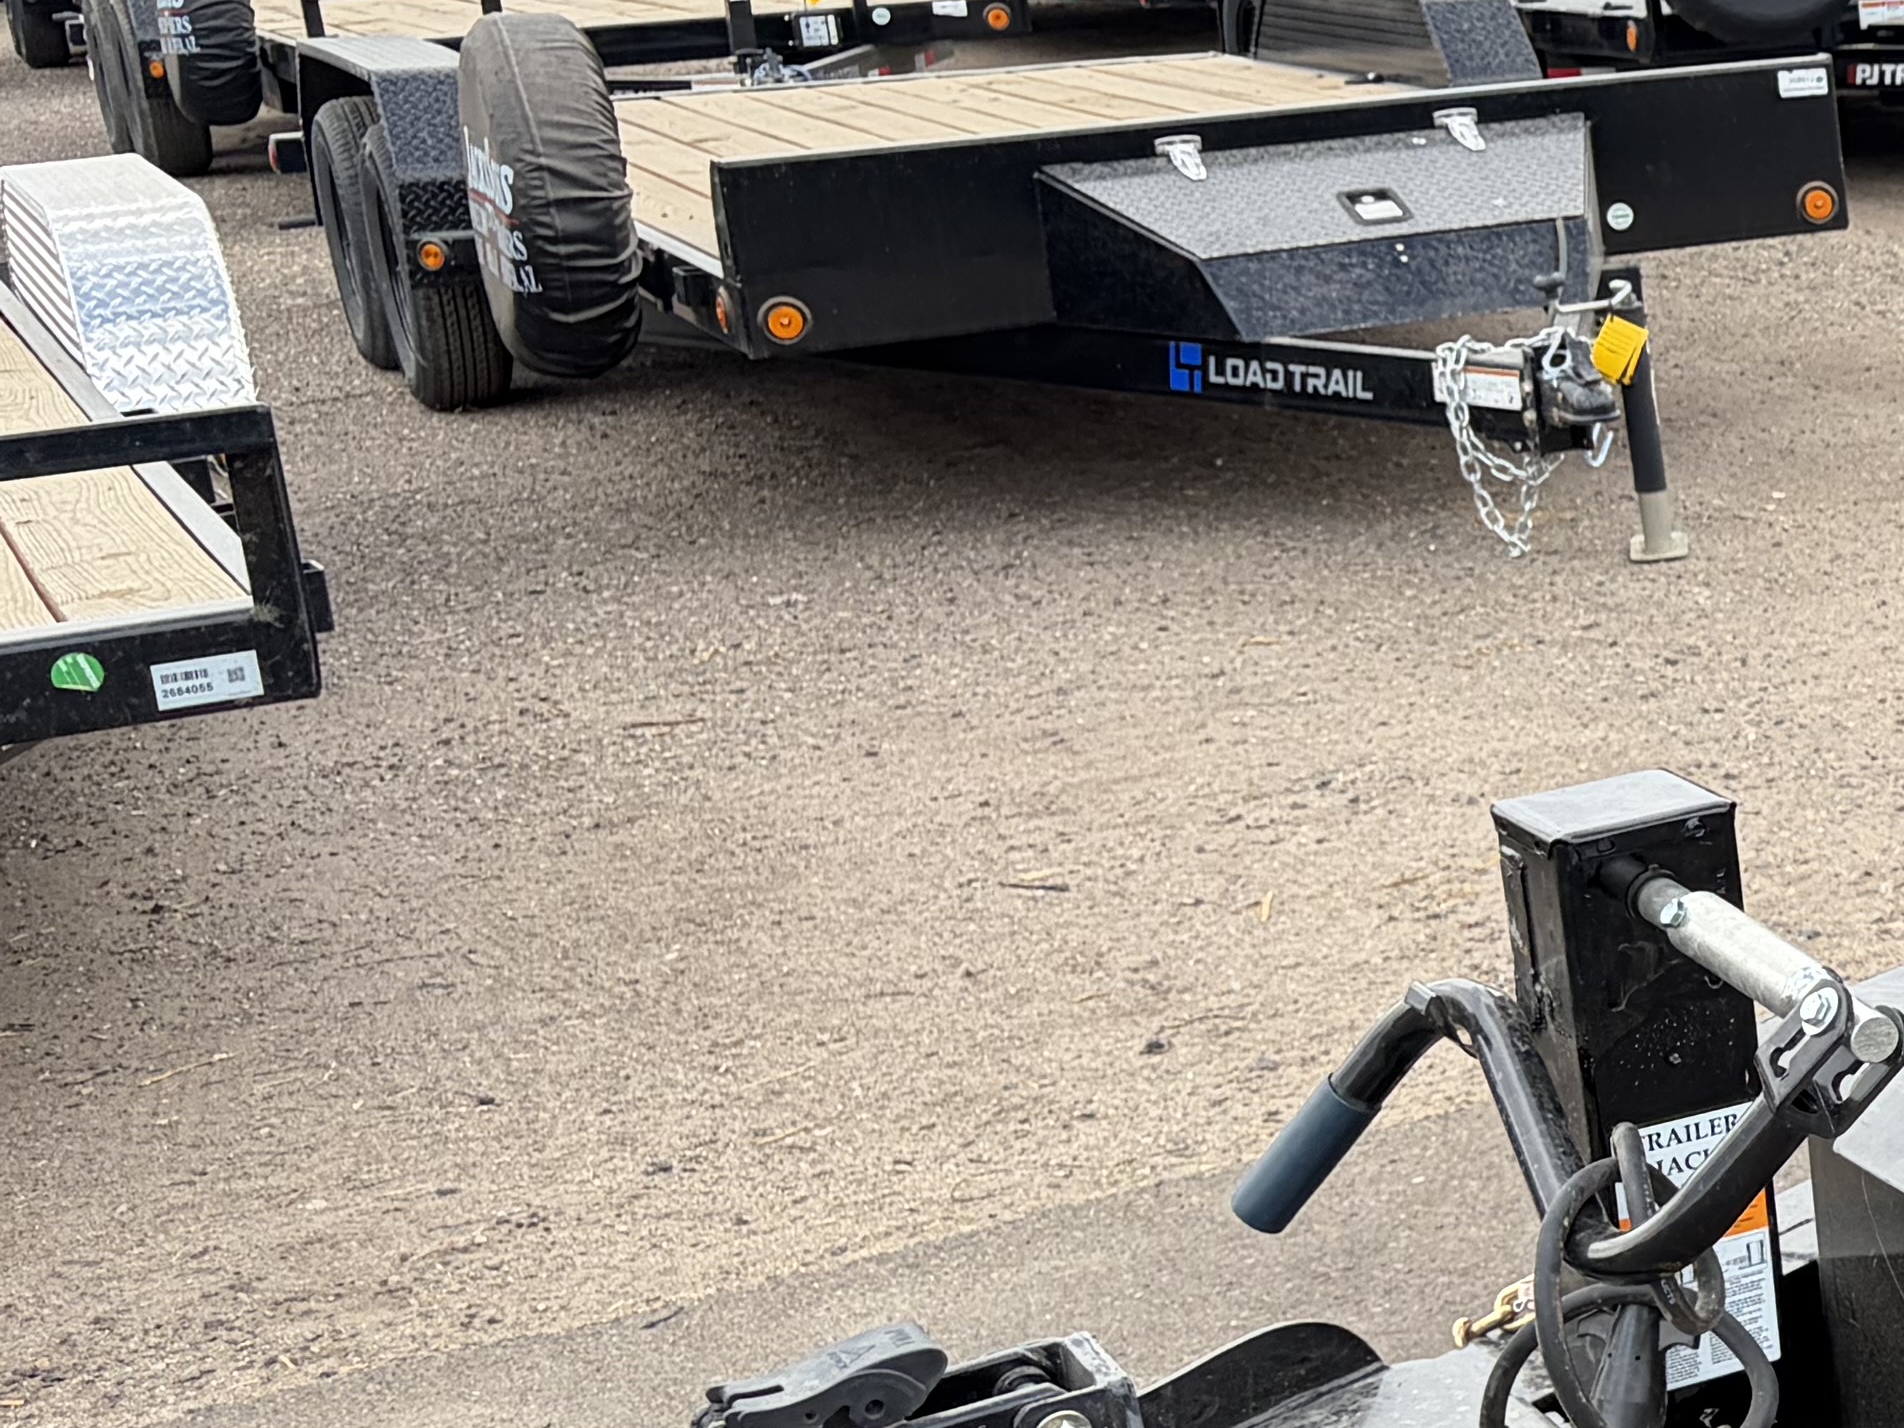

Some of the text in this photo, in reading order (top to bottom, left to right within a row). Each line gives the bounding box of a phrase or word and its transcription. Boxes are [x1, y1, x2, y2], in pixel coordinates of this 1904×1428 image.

[1856, 63, 1878, 86] PJ
[1208, 355, 1374, 401] LOAD TRAIL
[1642, 1113, 1738, 1151] RAILER
